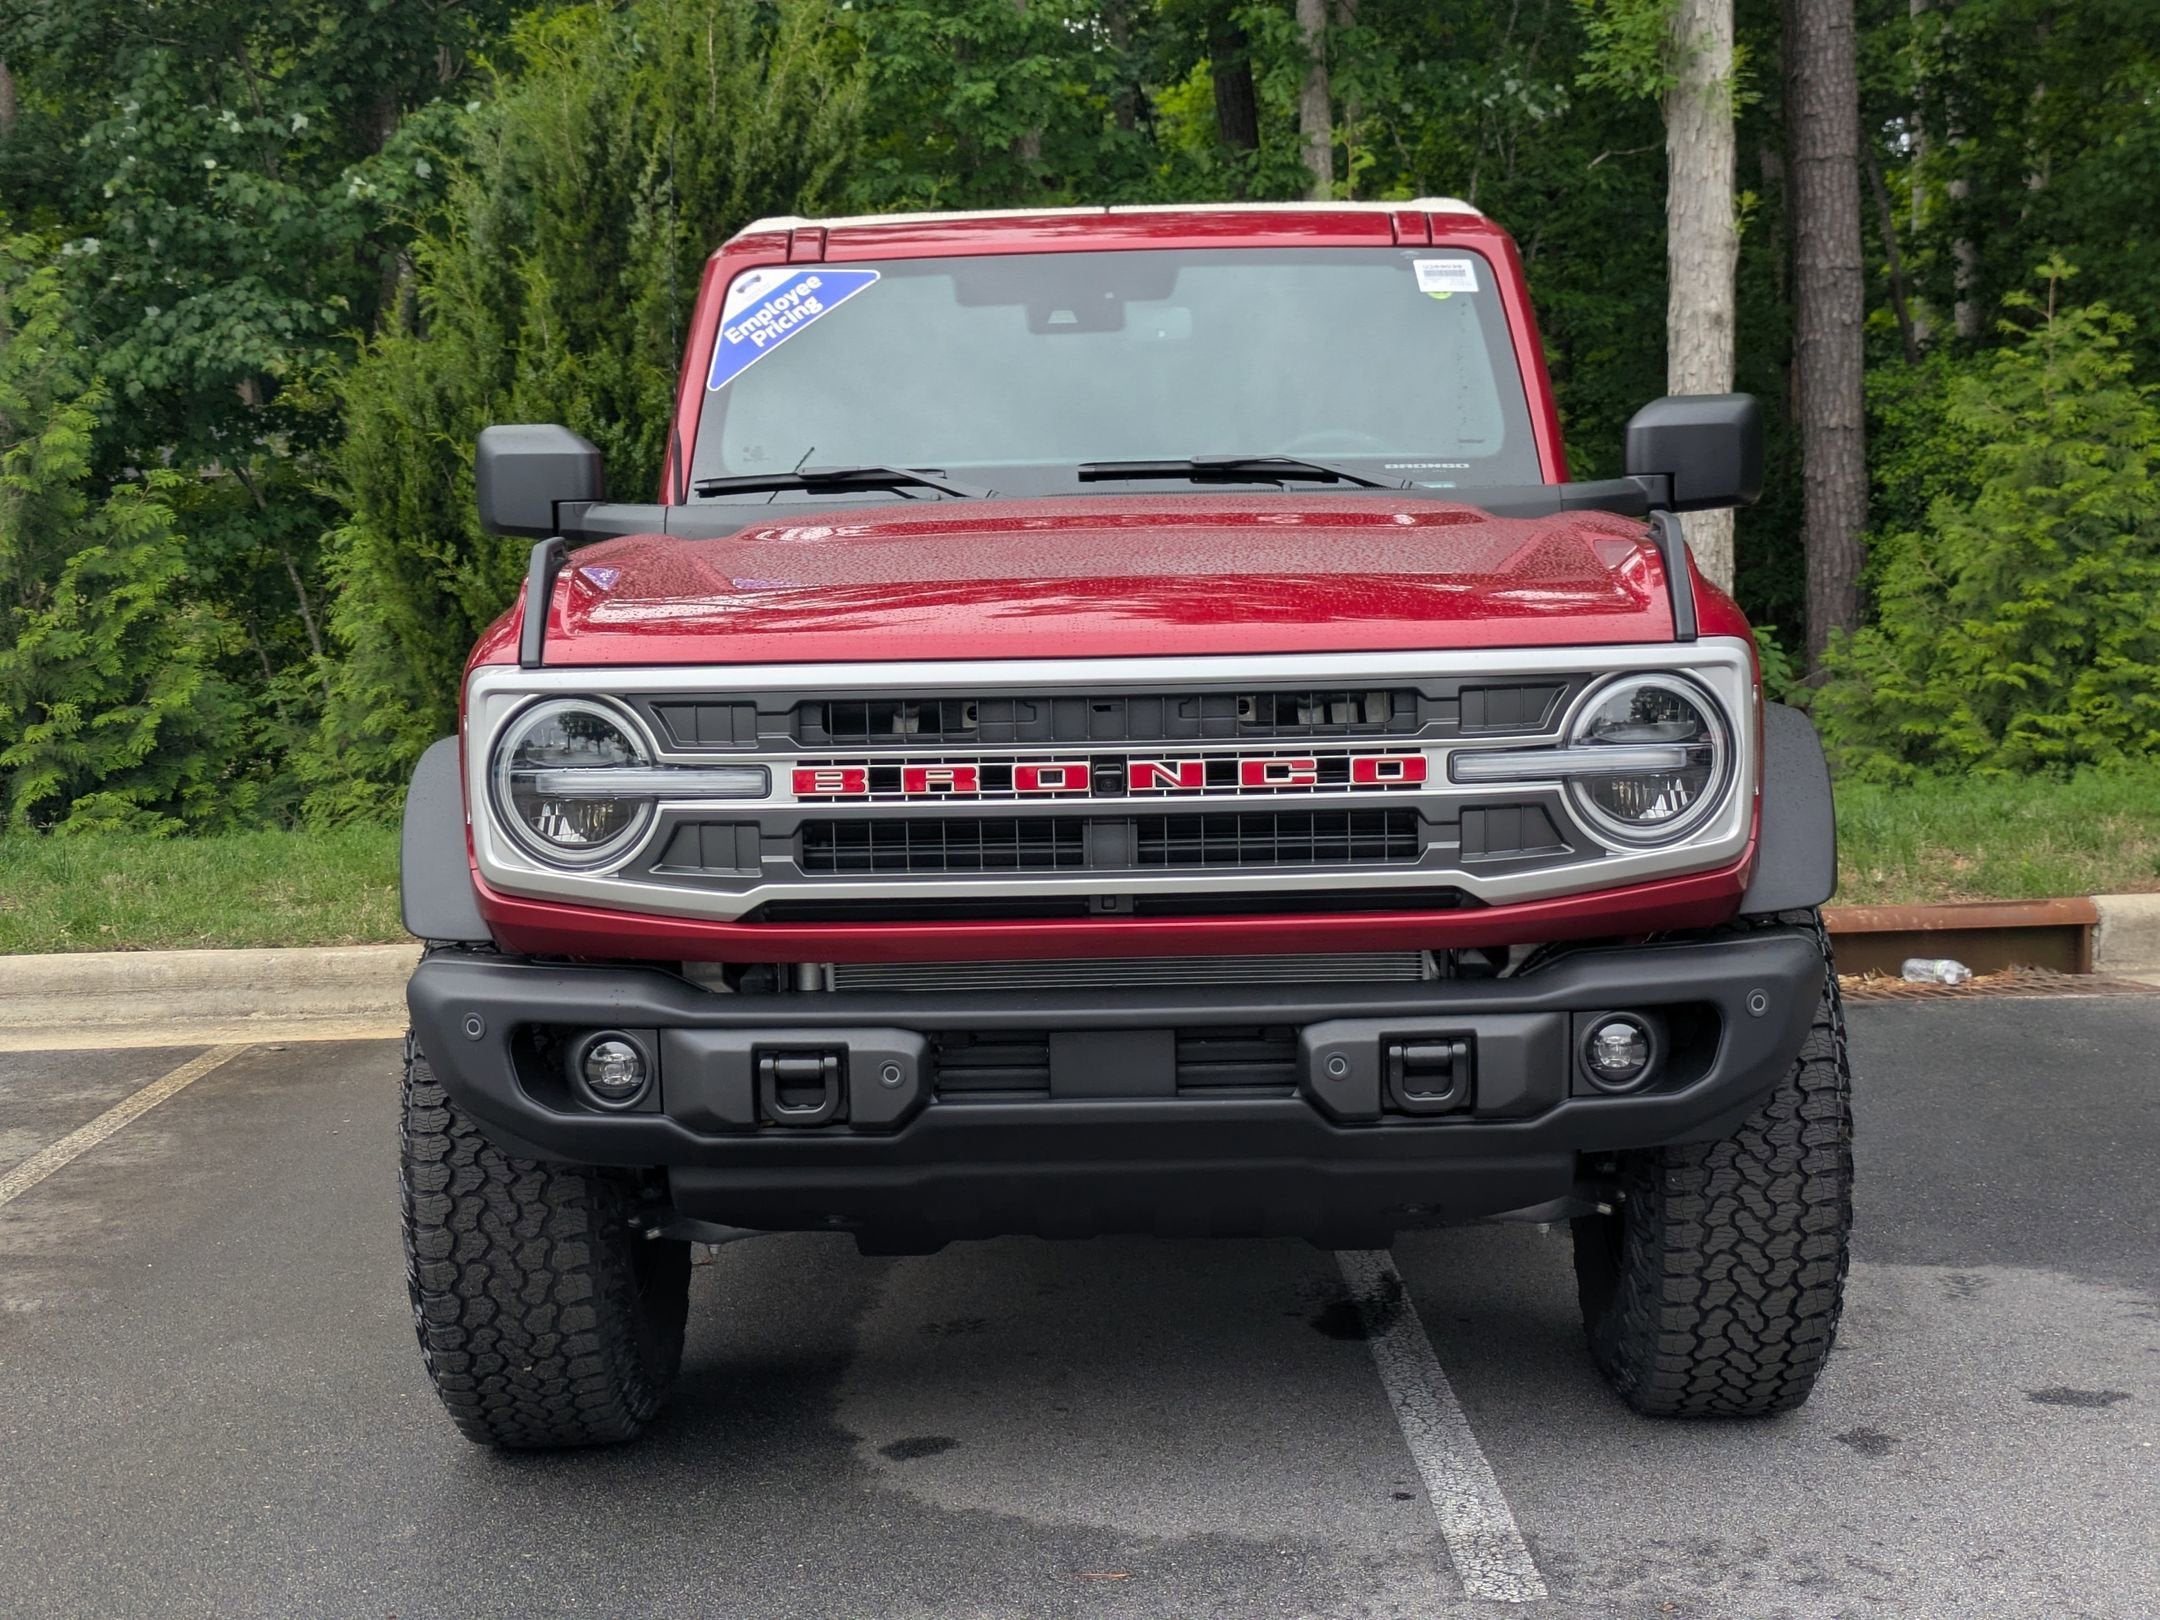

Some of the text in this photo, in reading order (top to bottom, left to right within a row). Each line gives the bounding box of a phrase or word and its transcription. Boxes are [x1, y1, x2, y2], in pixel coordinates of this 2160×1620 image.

[725, 276, 823, 344] Employee
[750, 296, 823, 347] Pricing
[790, 754, 1428, 797] BRONCO
